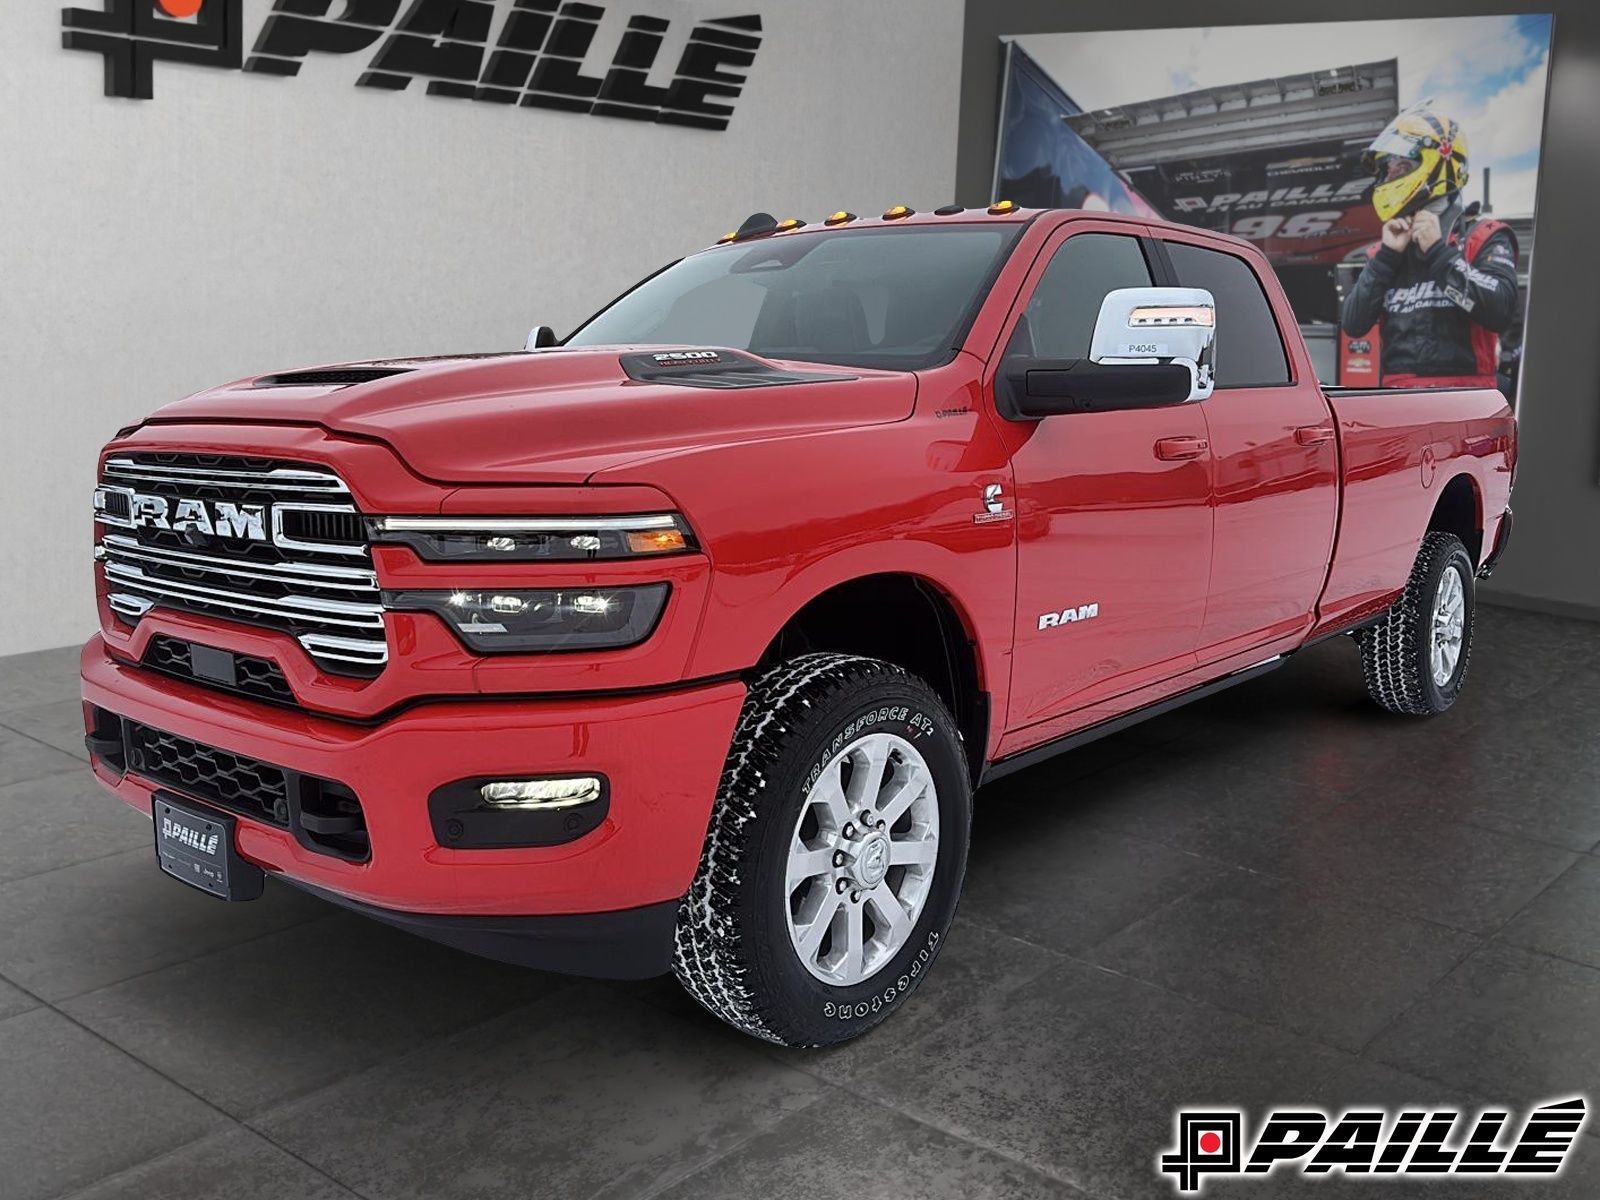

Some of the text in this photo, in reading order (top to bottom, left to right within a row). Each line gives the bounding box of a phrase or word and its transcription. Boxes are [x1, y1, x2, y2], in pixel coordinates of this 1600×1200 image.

[242, 0, 763, 132] PAILLÉ
[1270, 194, 1362, 208] CANADA
[1232, 210, 1343, 240] 96
[652, 351, 719, 361] 2500
[1128, 344, 1157, 353] P4045
[132, 493, 267, 541] RAM
[1038, 603, 1099, 631] RAM
[802, 706, 909, 795] TRANSFORCE
[823, 931, 940, 1020] Firestone
